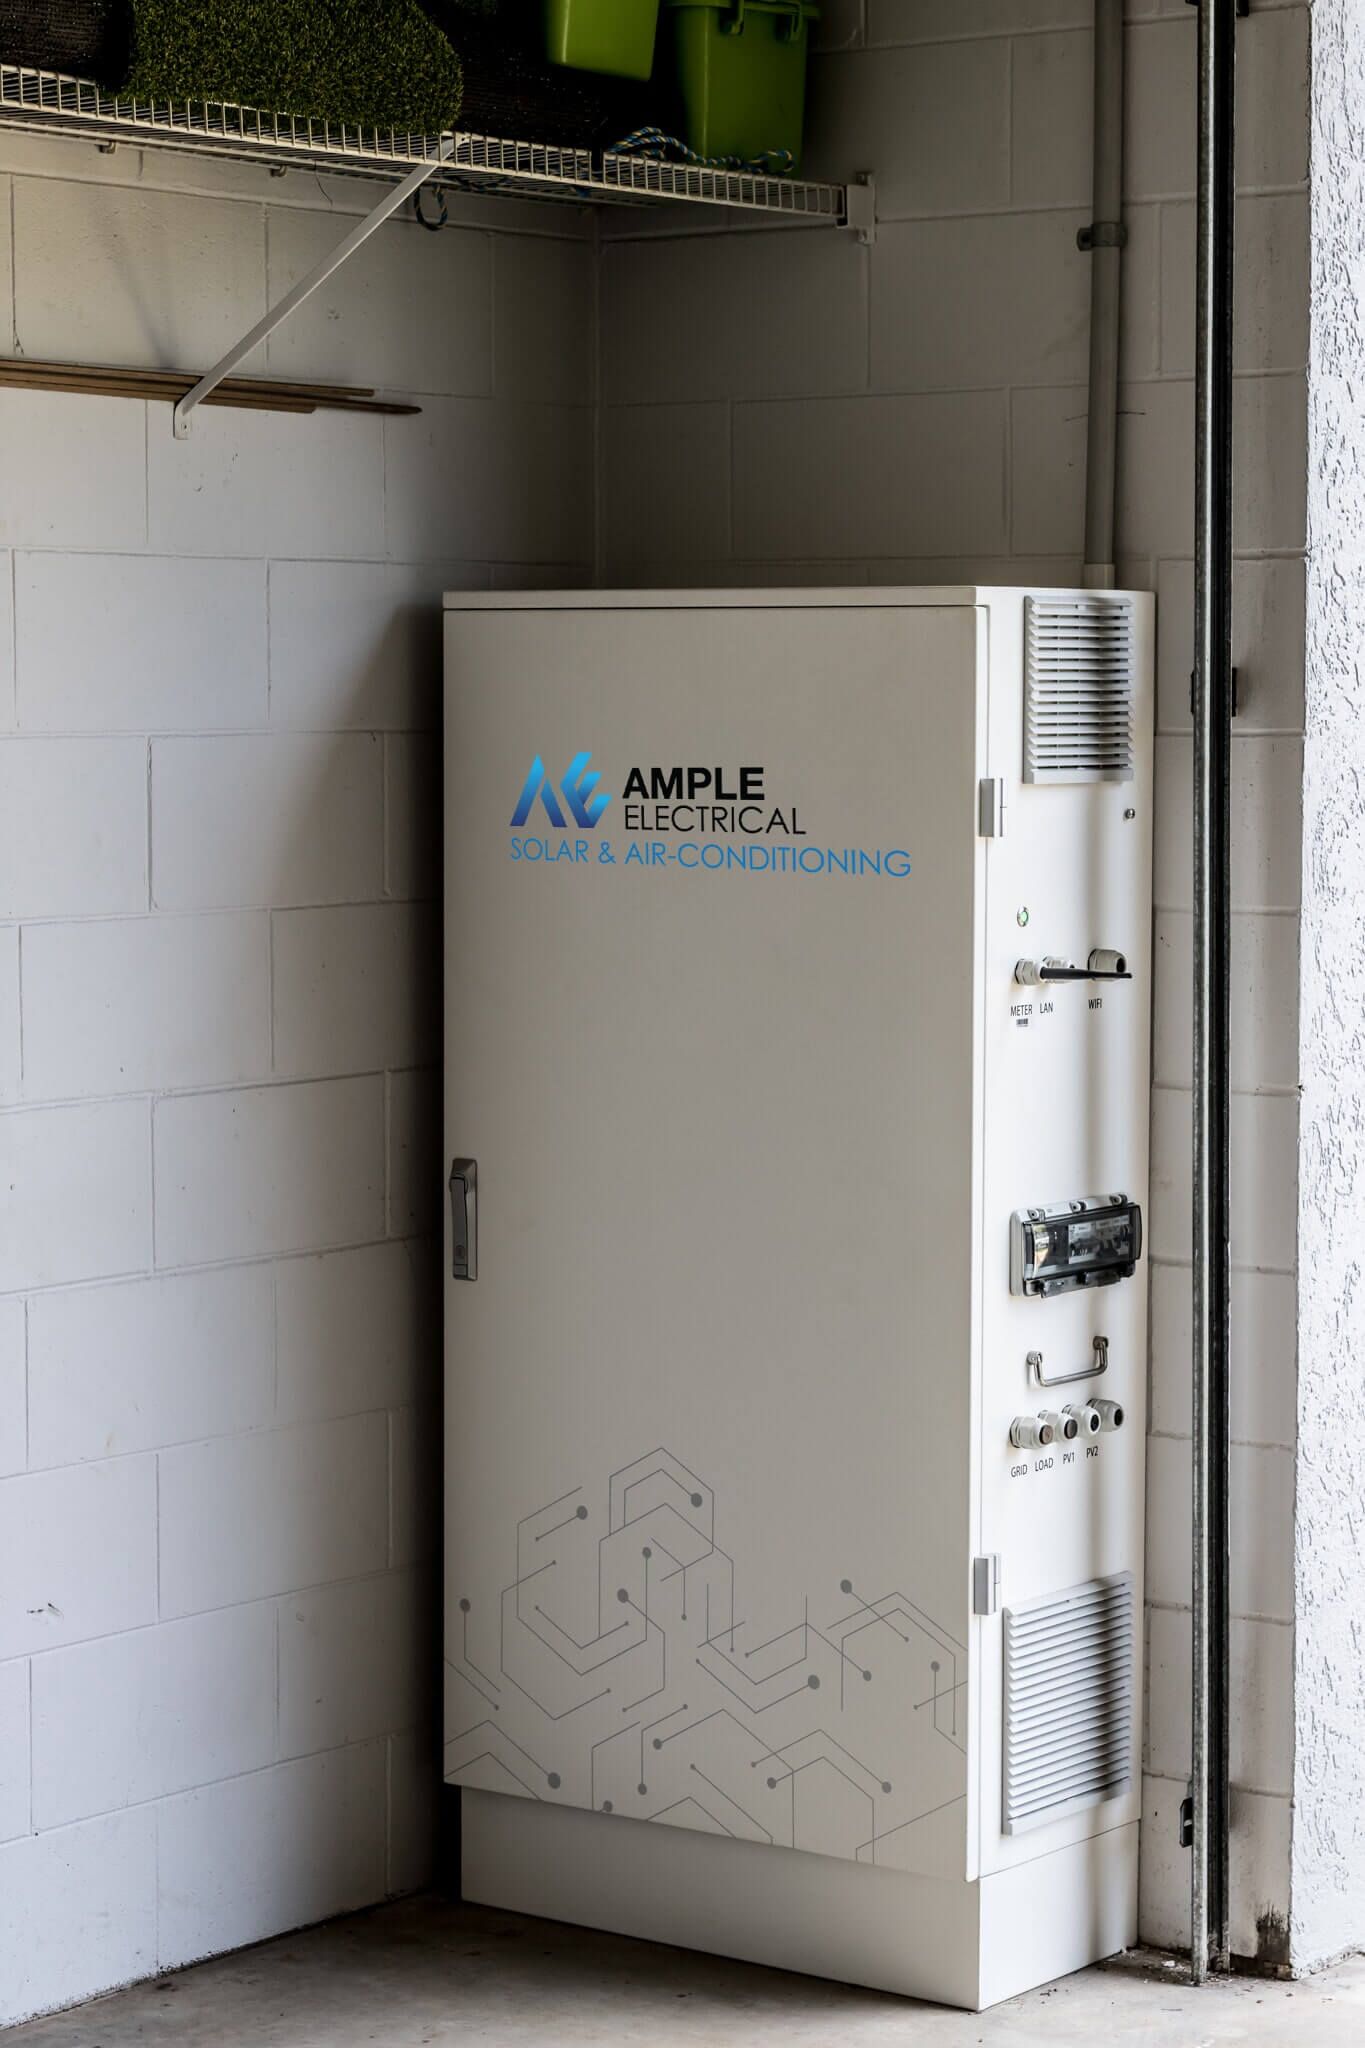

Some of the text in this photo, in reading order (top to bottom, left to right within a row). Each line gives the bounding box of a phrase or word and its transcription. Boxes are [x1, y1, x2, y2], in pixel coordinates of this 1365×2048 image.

[622, 767, 765, 801] AMPLE
[624, 805, 806, 835] ELECTRICAL
[510, 837, 911, 878] SOLAR & AIR-CONDITIONING
[1010, 998, 1103, 1017] METER LAN WIFI
[1010, 1445, 1099, 1478] GRID LOAD PV1 PV2
